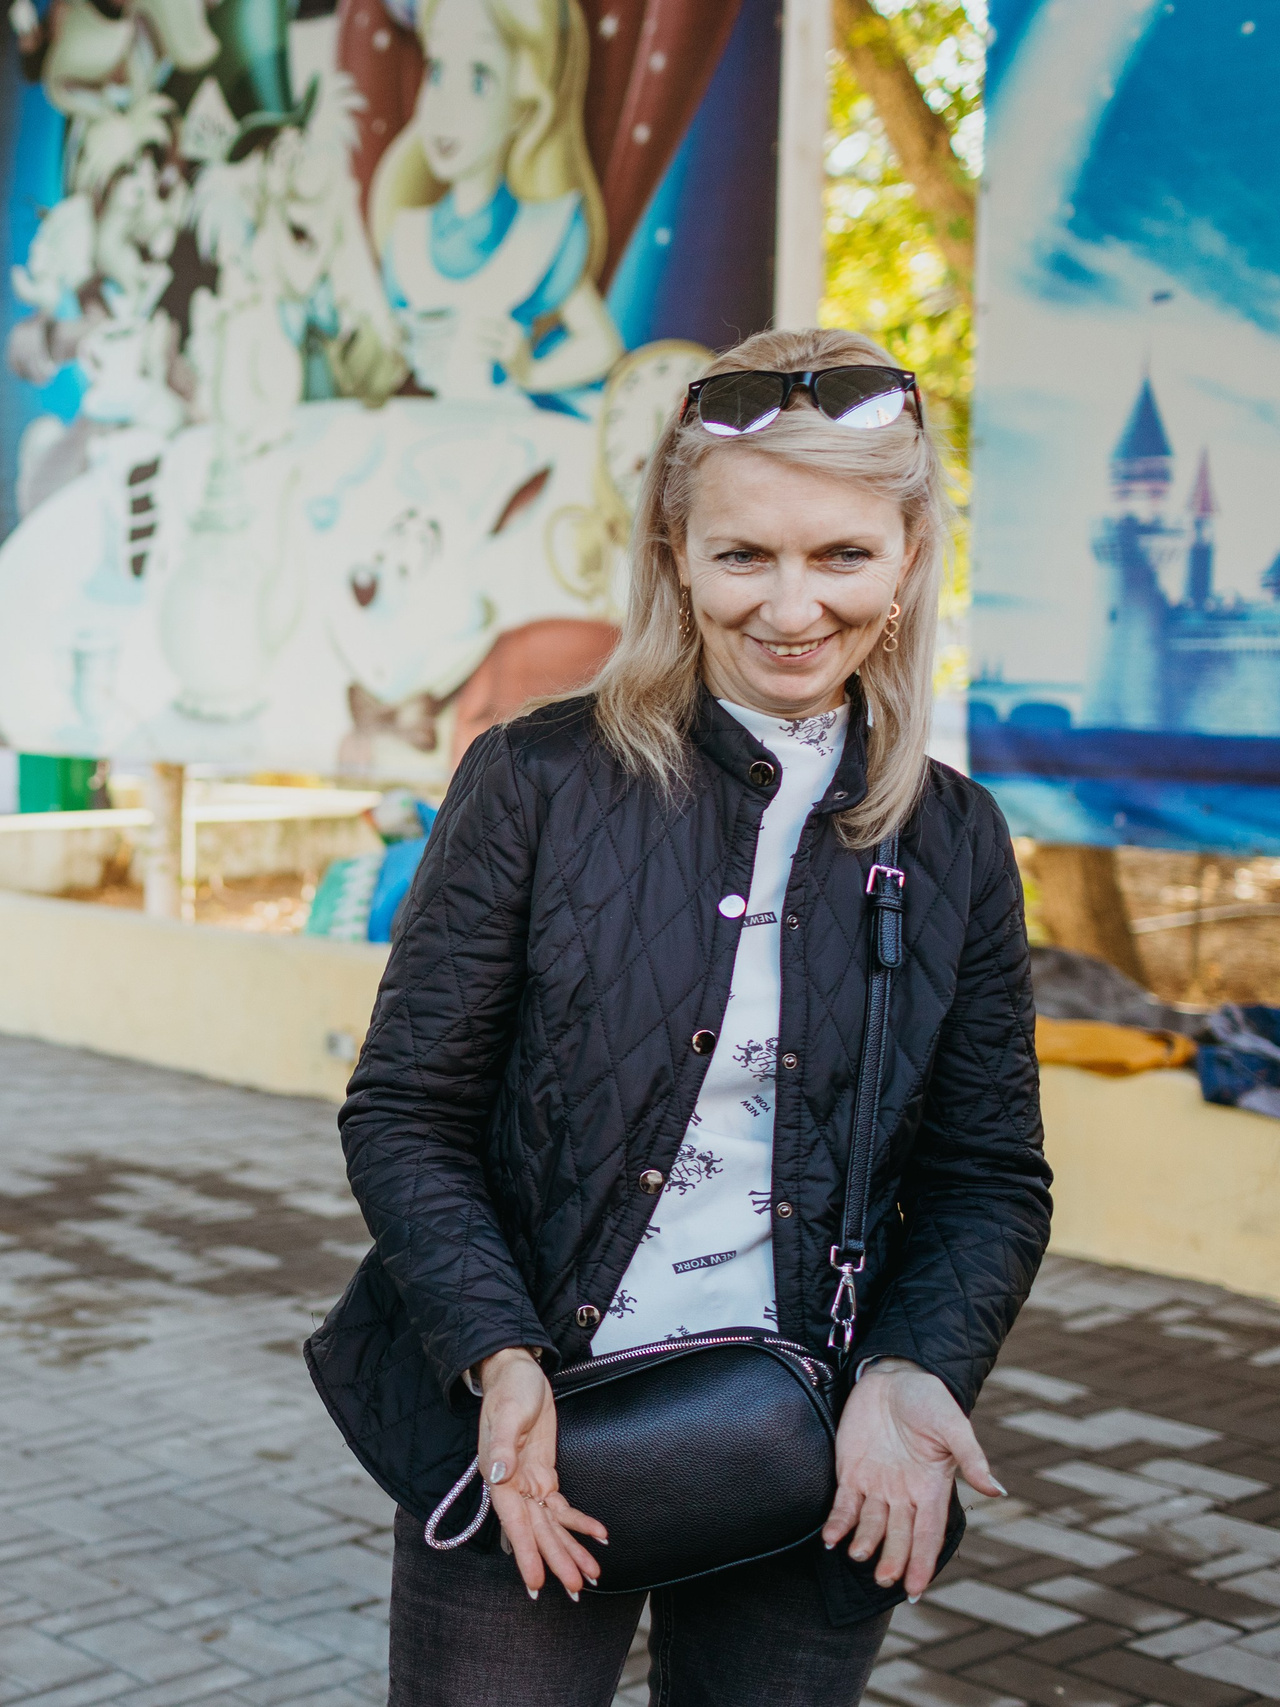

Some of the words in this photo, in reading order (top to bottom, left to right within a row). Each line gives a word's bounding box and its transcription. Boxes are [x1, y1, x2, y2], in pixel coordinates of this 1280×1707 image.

[749, 913, 775, 925] NEW
[740, 1100, 760, 1117] NEW
[751, 1094, 771, 1113] YORK
[675, 1258, 708, 1272] YORK
[710, 1252, 735, 1265] NEW
